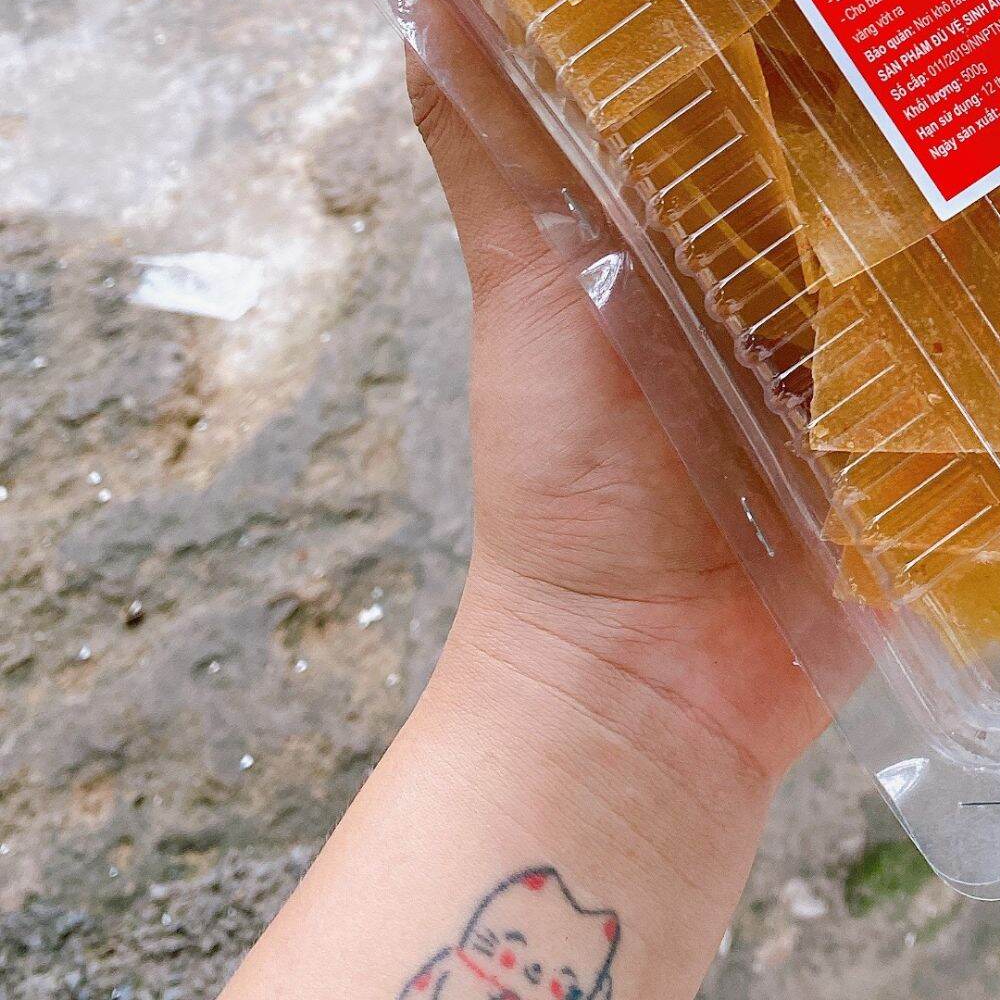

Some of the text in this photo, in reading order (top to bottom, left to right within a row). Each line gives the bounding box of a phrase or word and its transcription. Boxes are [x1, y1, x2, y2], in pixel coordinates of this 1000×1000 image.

[845, 4, 866, 20] Cho
[852, 24, 879, 43] vàng
[892, 6, 905, 18] ra
[913, 12, 933, 31] Nơi
[930, 1, 951, 20] khô
[946, 19, 965, 35] VỆ
[962, 3, 989, 26] SINH
[890, 83, 907, 101] Số
[907, 72, 929, 91] cấp:
[903, 62, 988, 121] Khối lượng: 500g
[916, 122, 939, 140] Hạn
[953, 93, 983, 116] dụng:
[981, 81, 996, 95] 12
[929, 137, 958, 159] Ngày
[975, 108, 1000, 130] xuất:
